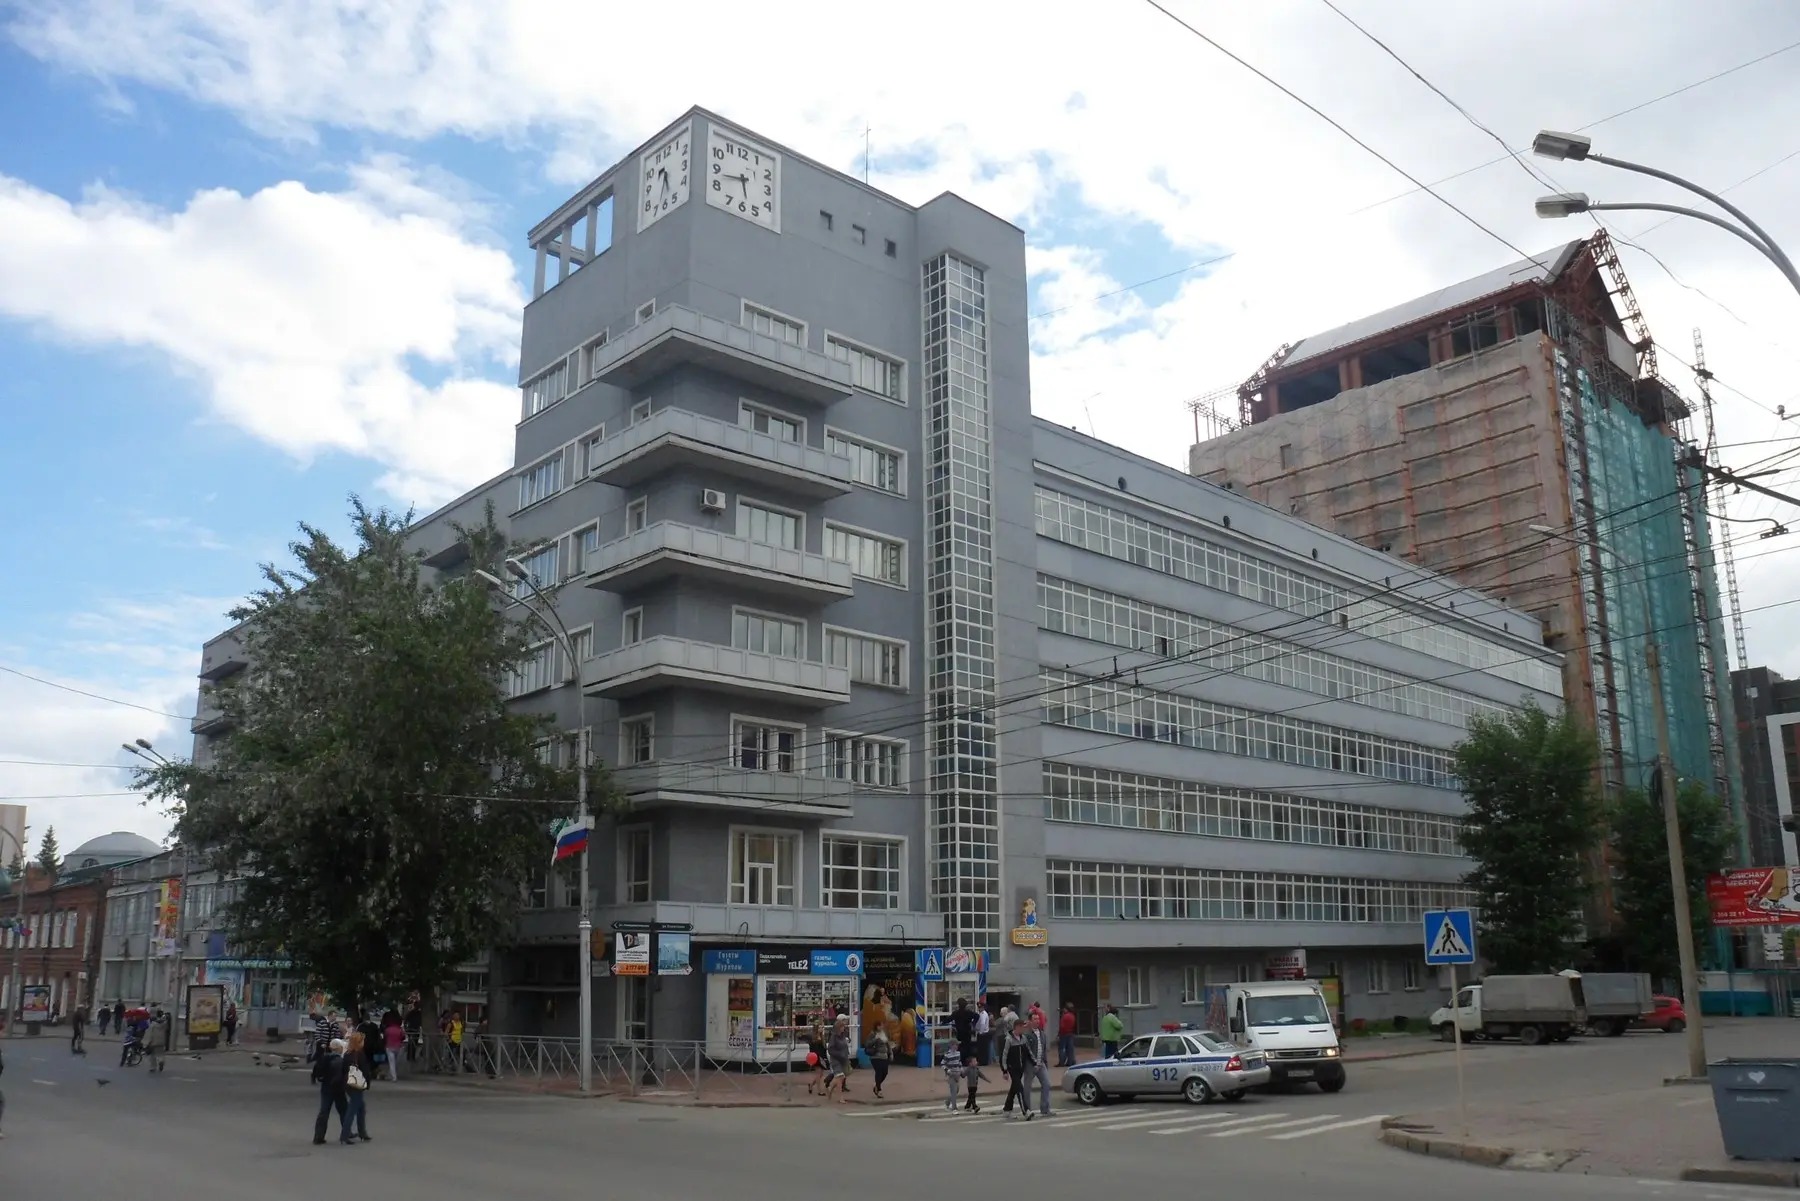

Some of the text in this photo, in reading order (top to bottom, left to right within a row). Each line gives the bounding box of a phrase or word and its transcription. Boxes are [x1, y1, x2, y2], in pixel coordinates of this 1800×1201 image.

[676, 140, 679, 150] 1
[682, 144, 688, 156] 2
[726, 143, 733, 154] 11
[664, 146, 671, 158] 12
[713, 147, 724, 160] 10
[738, 148, 748, 160] 12
[655, 155, 661, 164] 11
[755, 156, 758, 166] 1
[682, 160, 687, 171] 3
[713, 164, 720, 174] 9
[646, 168, 654, 180] 10
[764, 169, 771, 180] 2
[681, 176, 686, 186] 4
[713, 181, 721, 191] 8
[646, 185, 651, 195] 9
[764, 185, 771, 196] 3
[672, 192, 677, 204] 5
[726, 195, 733, 205] 7
[645, 201, 651, 212] 8
[662, 199, 668, 210] 6
[738, 202, 746, 212] 6
[764, 201, 771, 212] 4
[653, 204, 659, 217] 7
[751, 206, 759, 216] 5
[718, 951, 739, 959] Газеты
[788, 959, 808, 970] TELE2
[1152, 1067, 1178, 1081] 912
